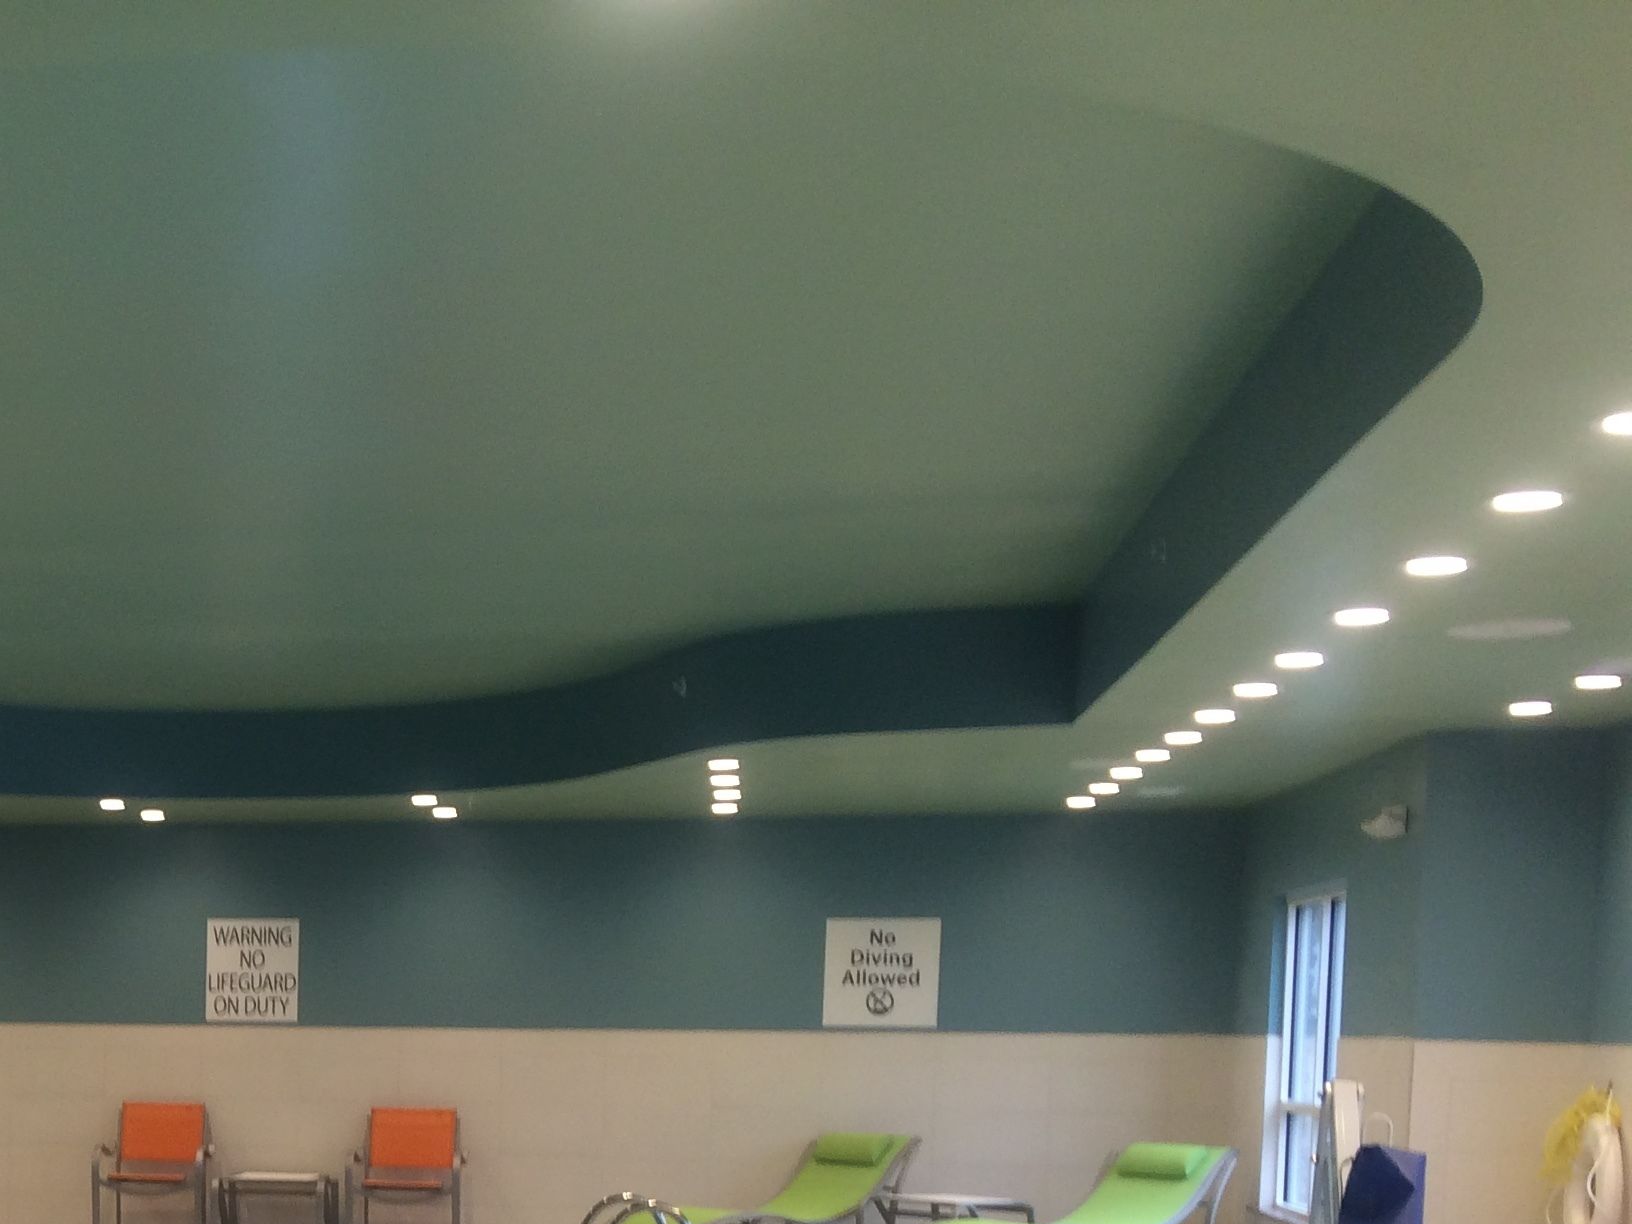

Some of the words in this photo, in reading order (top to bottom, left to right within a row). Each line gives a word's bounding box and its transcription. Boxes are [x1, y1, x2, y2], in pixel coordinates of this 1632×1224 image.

[213, 925, 292, 948] WARNING
[869, 928, 896, 946] No
[240, 949, 265, 969] NO
[851, 949, 913, 968] Diving
[208, 972, 296, 994] LIFEGUARD
[842, 969, 920, 987] Allowed
[214, 995, 239, 1016] ON
[245, 995, 289, 1016] DUTY
